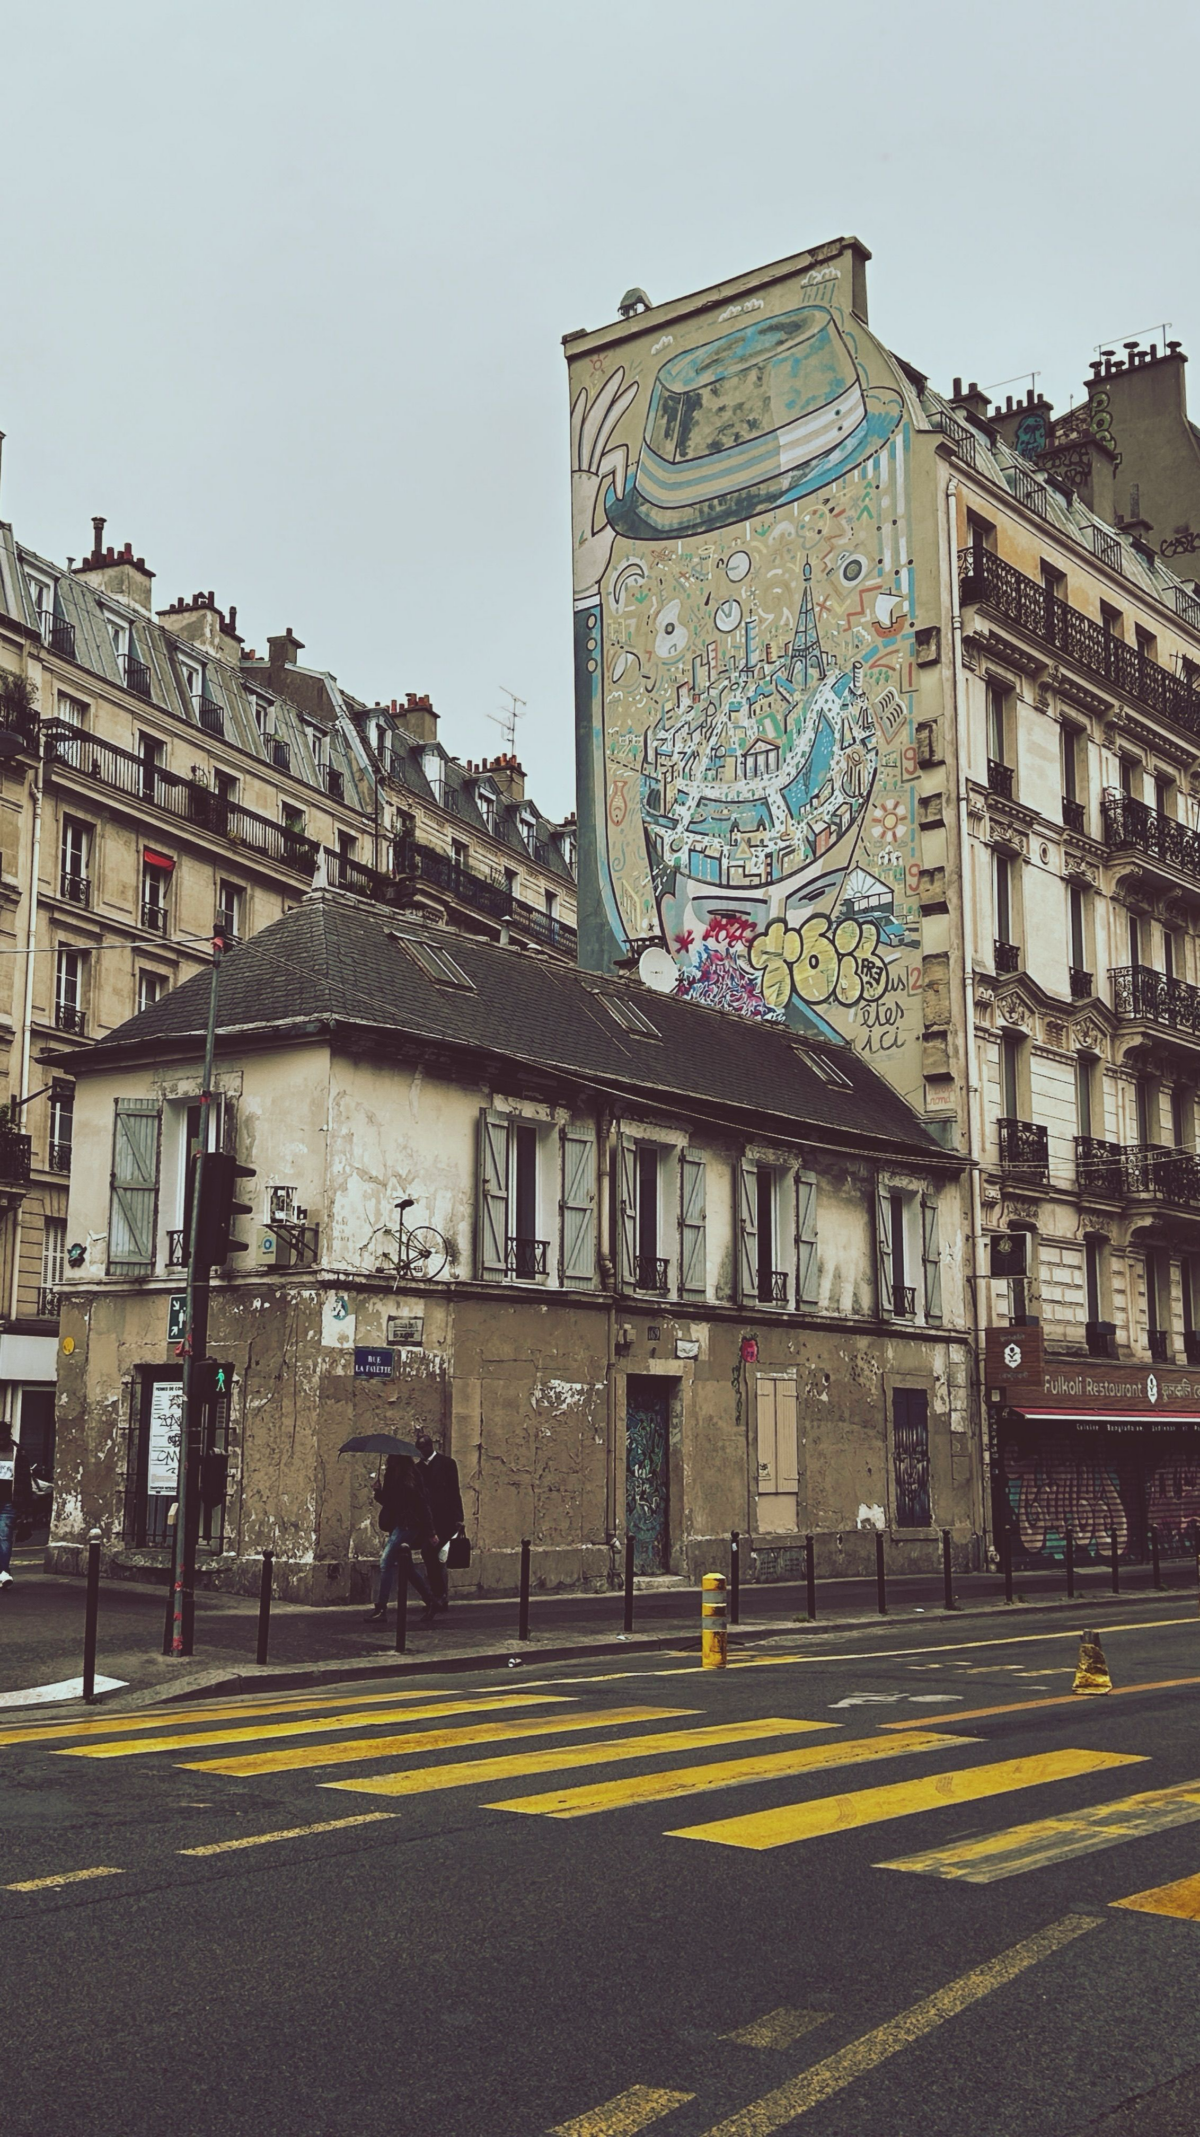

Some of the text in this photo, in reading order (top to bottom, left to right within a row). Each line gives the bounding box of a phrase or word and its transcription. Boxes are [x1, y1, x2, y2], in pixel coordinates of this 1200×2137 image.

[860, 1000, 904, 1029] êtes
[861, 1026, 906, 1055] ici
[355, 1364, 364, 1373] LA
[367, 1355, 381, 1364] RUE
[1044, 1375, 1083, 1396] Fulkoli
[1086, 1378, 1143, 1398] Restaurant
